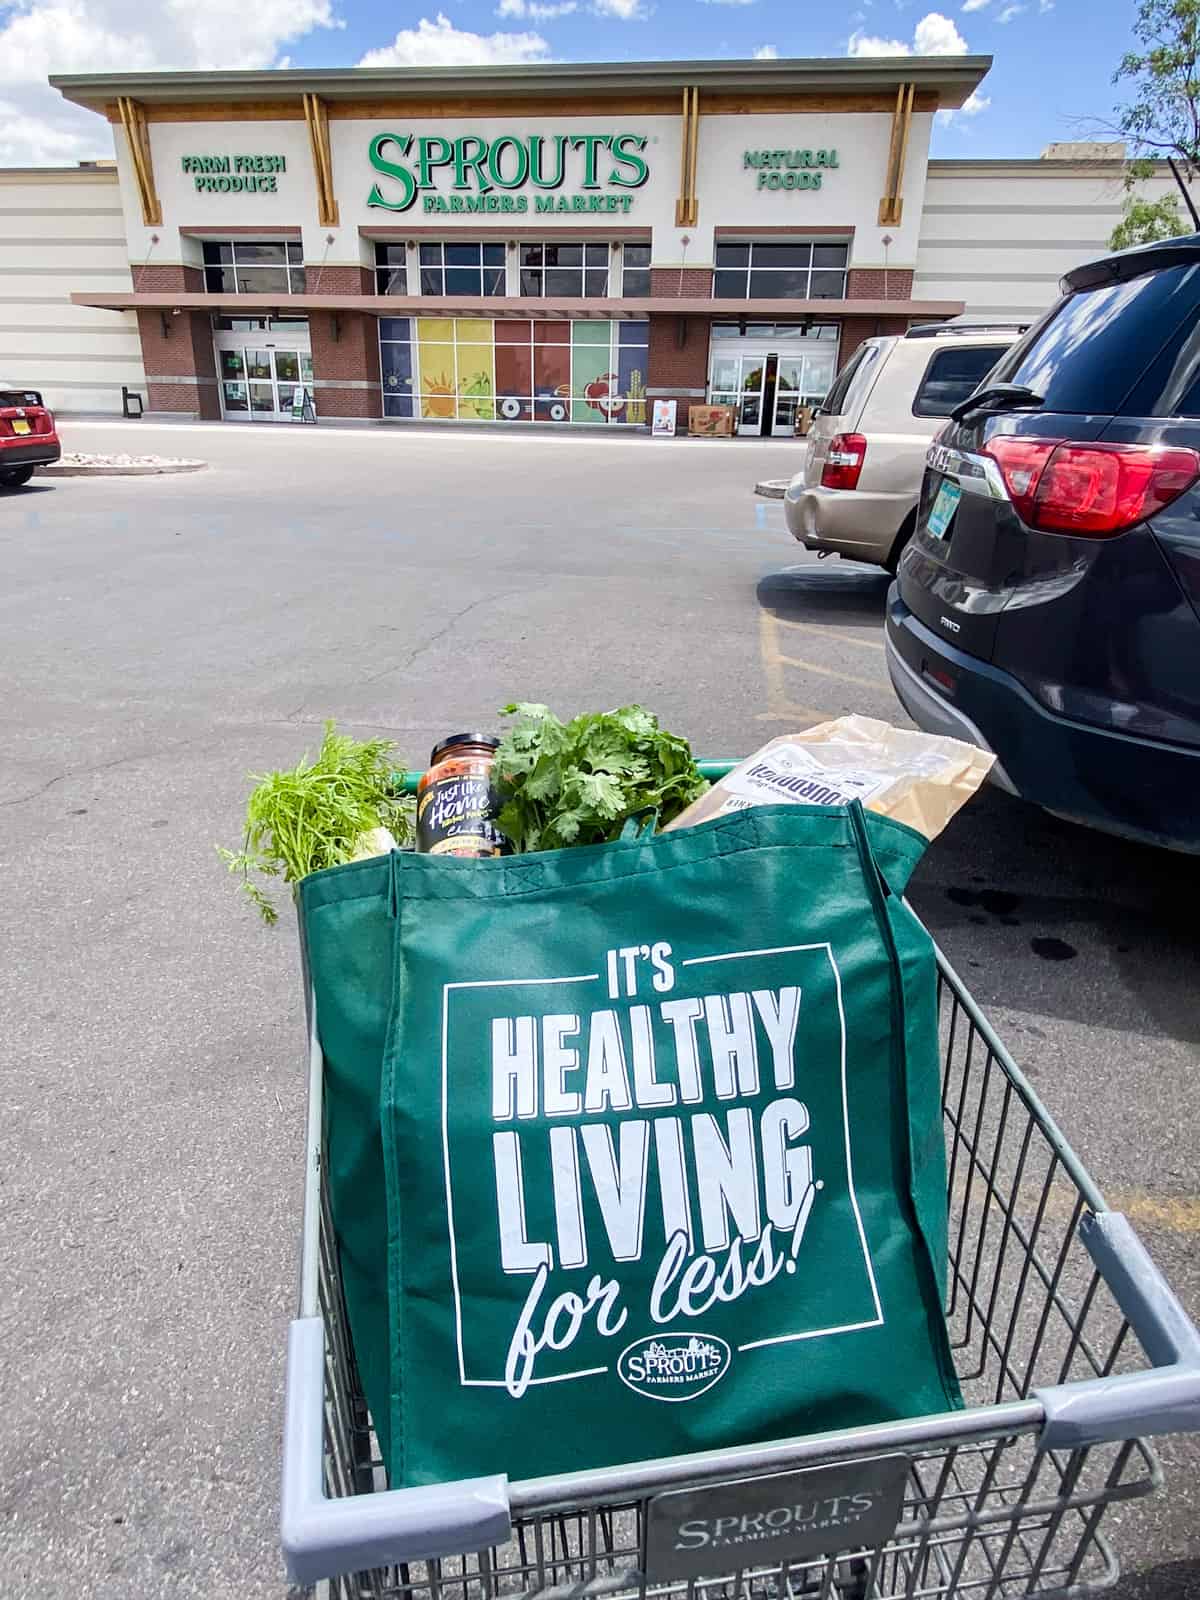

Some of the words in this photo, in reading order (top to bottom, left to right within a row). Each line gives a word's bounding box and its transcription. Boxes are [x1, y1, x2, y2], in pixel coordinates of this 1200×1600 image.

[182, 155, 230, 173] FARM
[233, 155, 286, 173] FRESH
[367, 133, 649, 211] SPROUTS
[743, 149, 840, 170] NATURAL
[194, 176, 278, 192] PRODUCE
[757, 171, 822, 191] FOODS
[423, 194, 528, 213] FARMERS
[535, 194, 633, 213] MARKET
[435, 783, 458, 805] Just
[429, 795, 490, 829] Home
[607, 941, 675, 999] IT'S
[491, 985, 802, 1121] HEALTHY
[504, 1263, 628, 1399] for
[650, 1182, 816, 1324] less!
[628, 1347, 722, 1381] SPROUTS
[646, 1374, 684, 1384] FARMERS
[685, 1367, 719, 1382] MARKET
[674, 1492, 874, 1550] SPROUTS
[711, 1528, 791, 1548] FARMERS
[795, 1514, 862, 1533] MARKET
